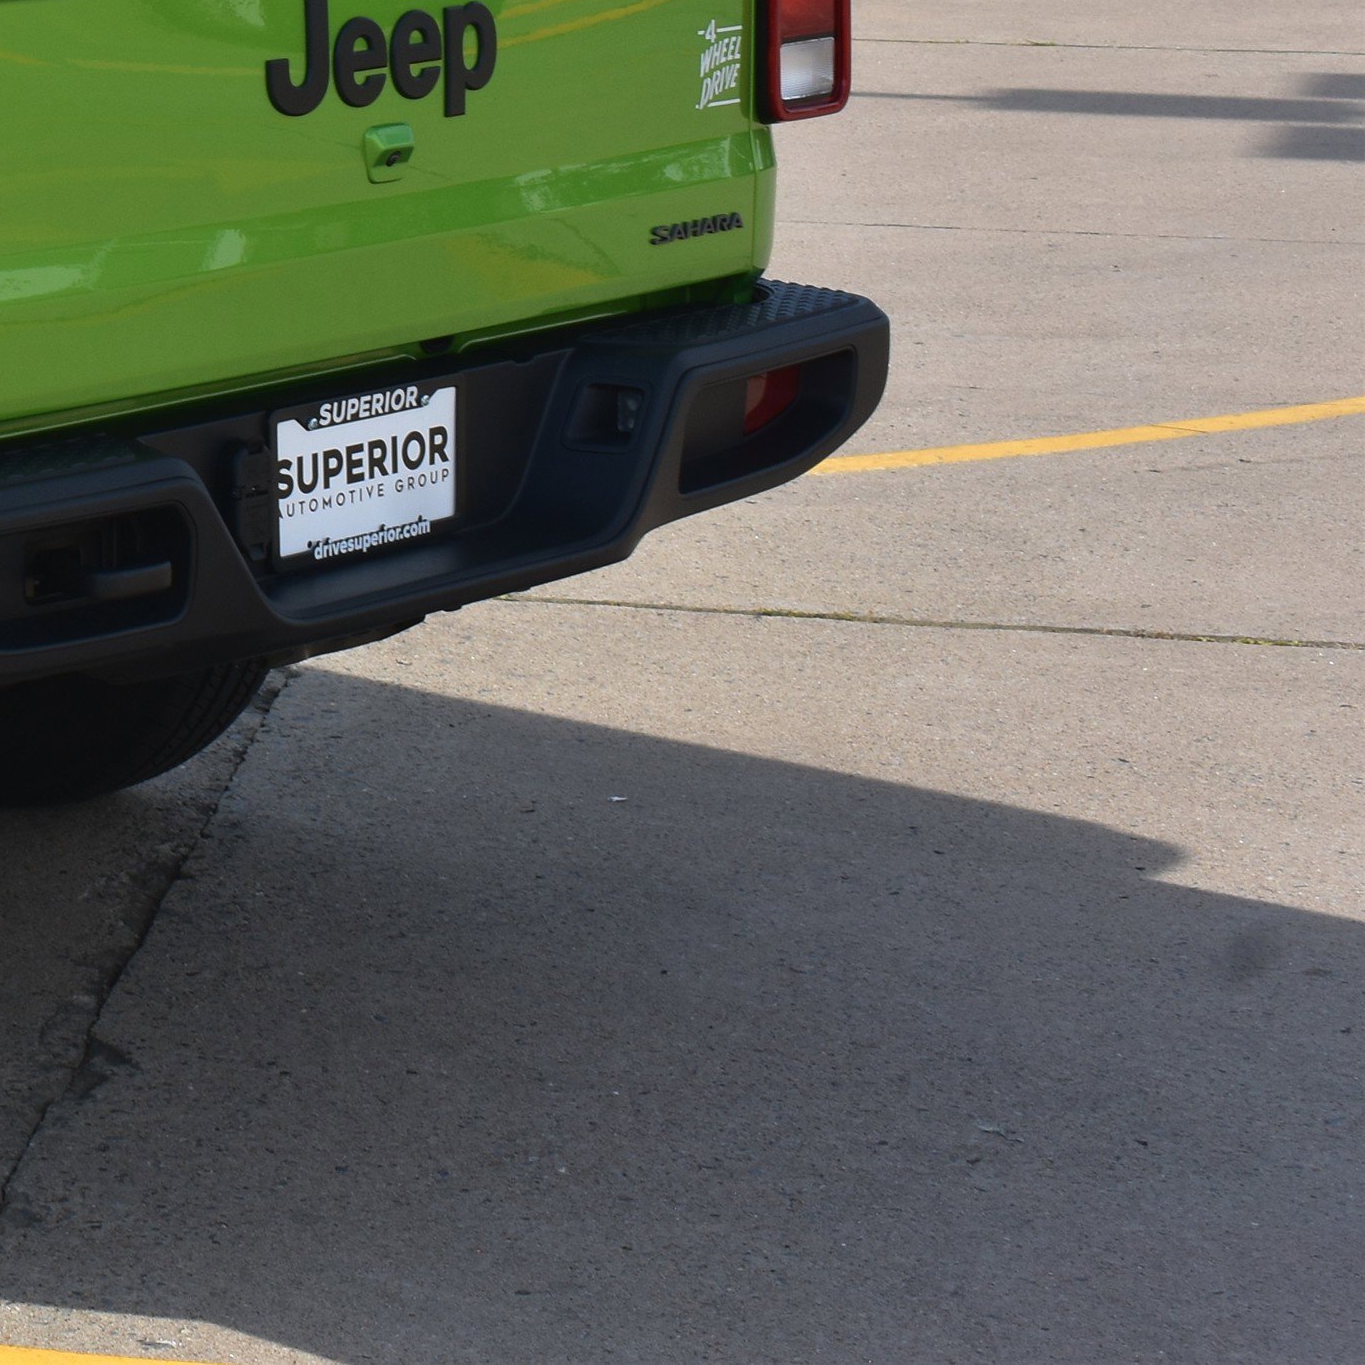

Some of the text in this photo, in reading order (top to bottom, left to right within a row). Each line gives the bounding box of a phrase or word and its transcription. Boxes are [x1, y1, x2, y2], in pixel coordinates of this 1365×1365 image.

[704, 19, 716, 43] 4
[700, 35, 742, 77] WHEEL
[696, 63, 741, 110] DRIVE
[649, 211, 744, 246] SAHARA
[319, 385, 418, 427] SUPERIOR
[277, 424, 449, 500] SUPERIOR
[395, 467, 451, 493] GROUP
[313, 518, 432, 561] drivesuperior.com
